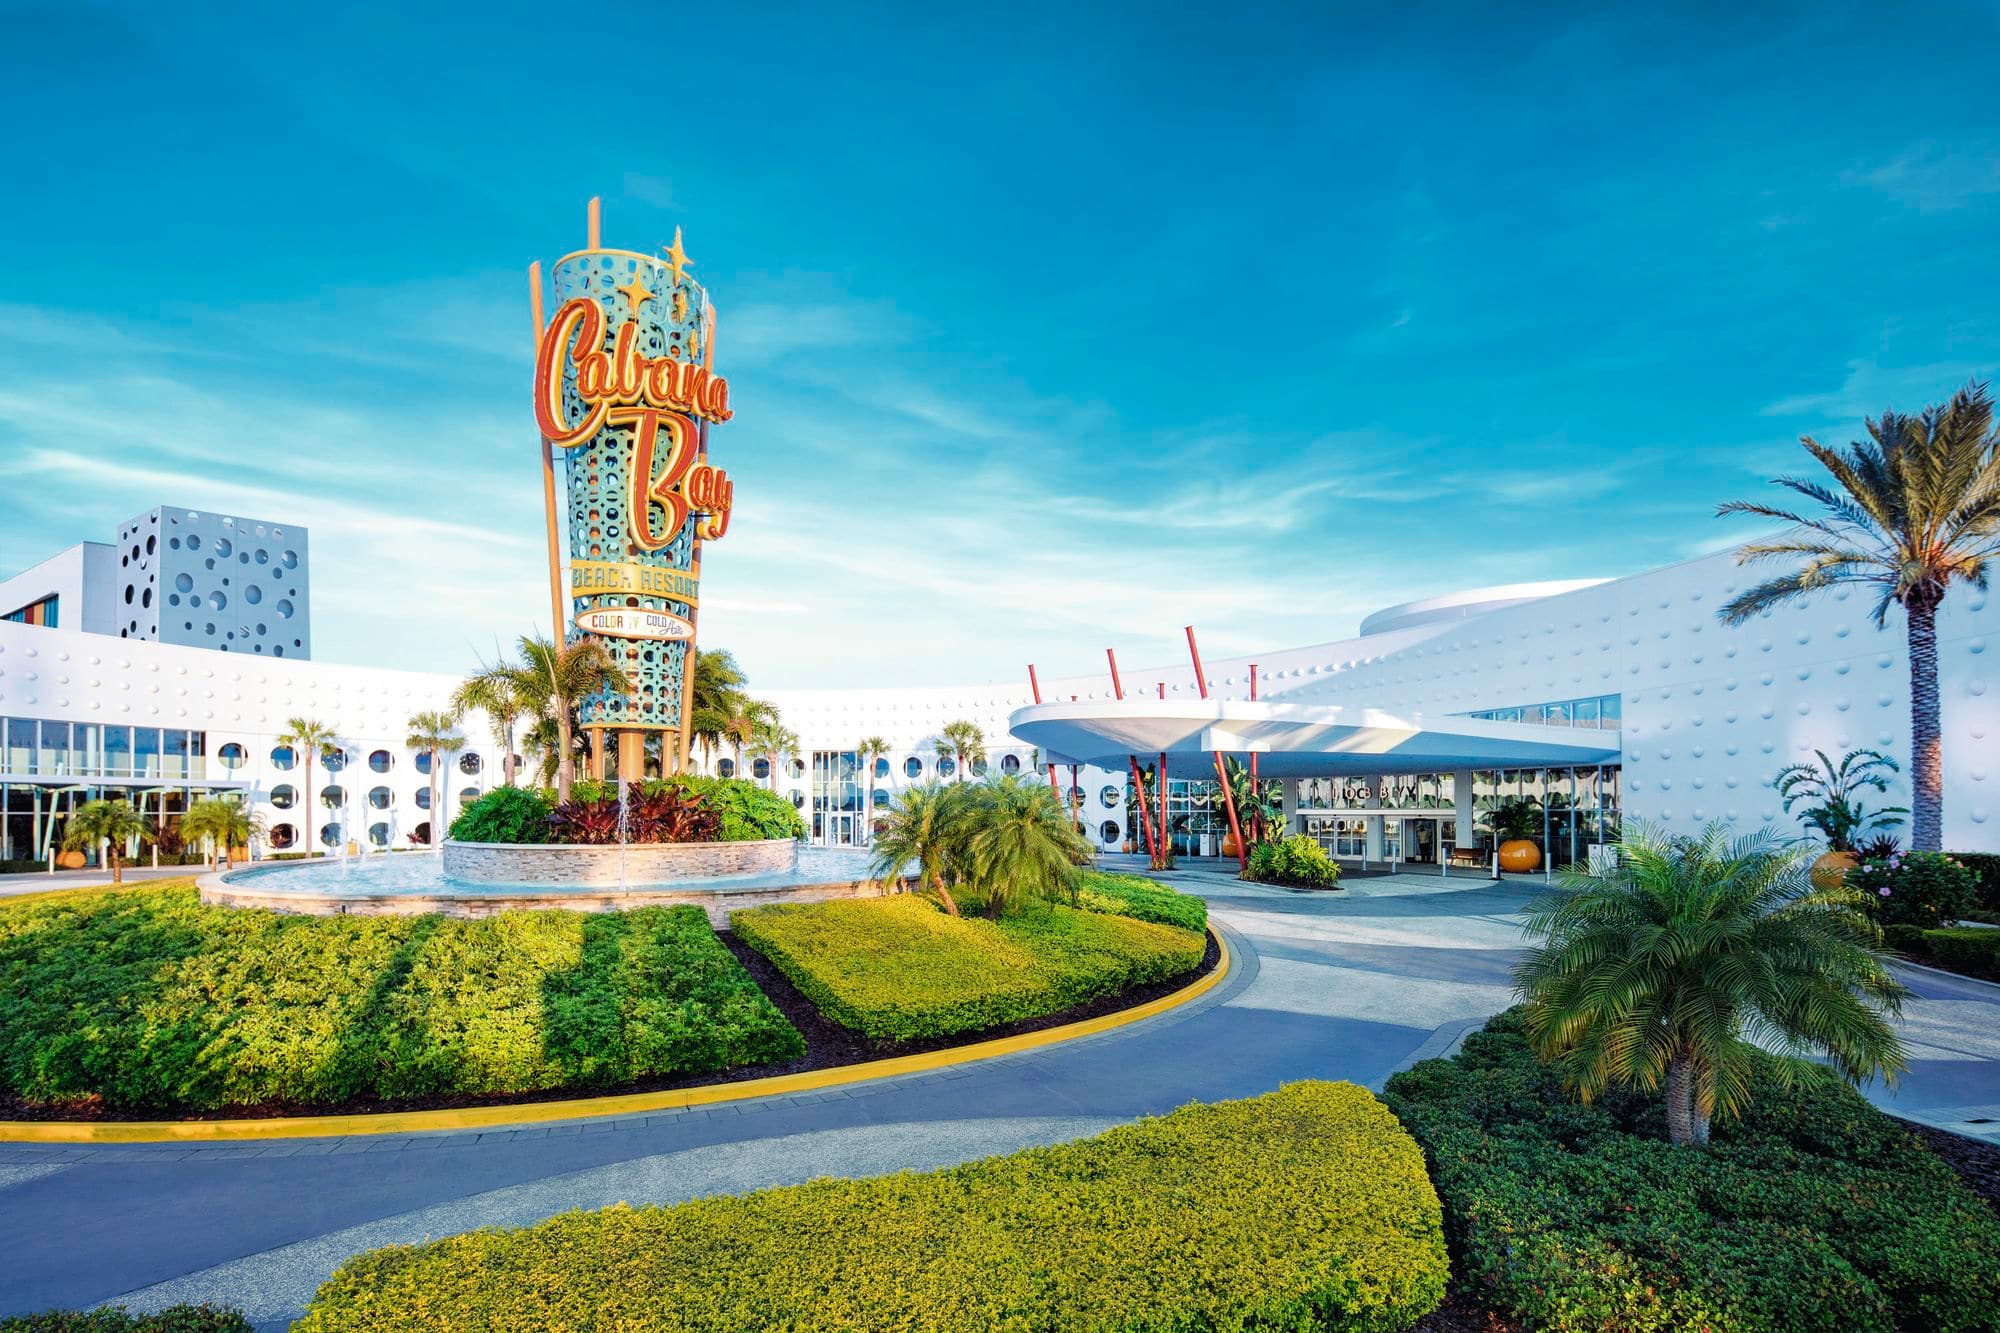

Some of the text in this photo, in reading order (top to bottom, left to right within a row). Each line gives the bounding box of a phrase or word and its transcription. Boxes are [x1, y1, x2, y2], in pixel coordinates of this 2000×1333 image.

[534, 297, 734, 448] Cabana
[606, 407, 733, 551] Bay
[572, 567, 699, 599] BEACH RESORT
[592, 614, 624, 628] COLOR
[646, 614, 667, 628] COLD
